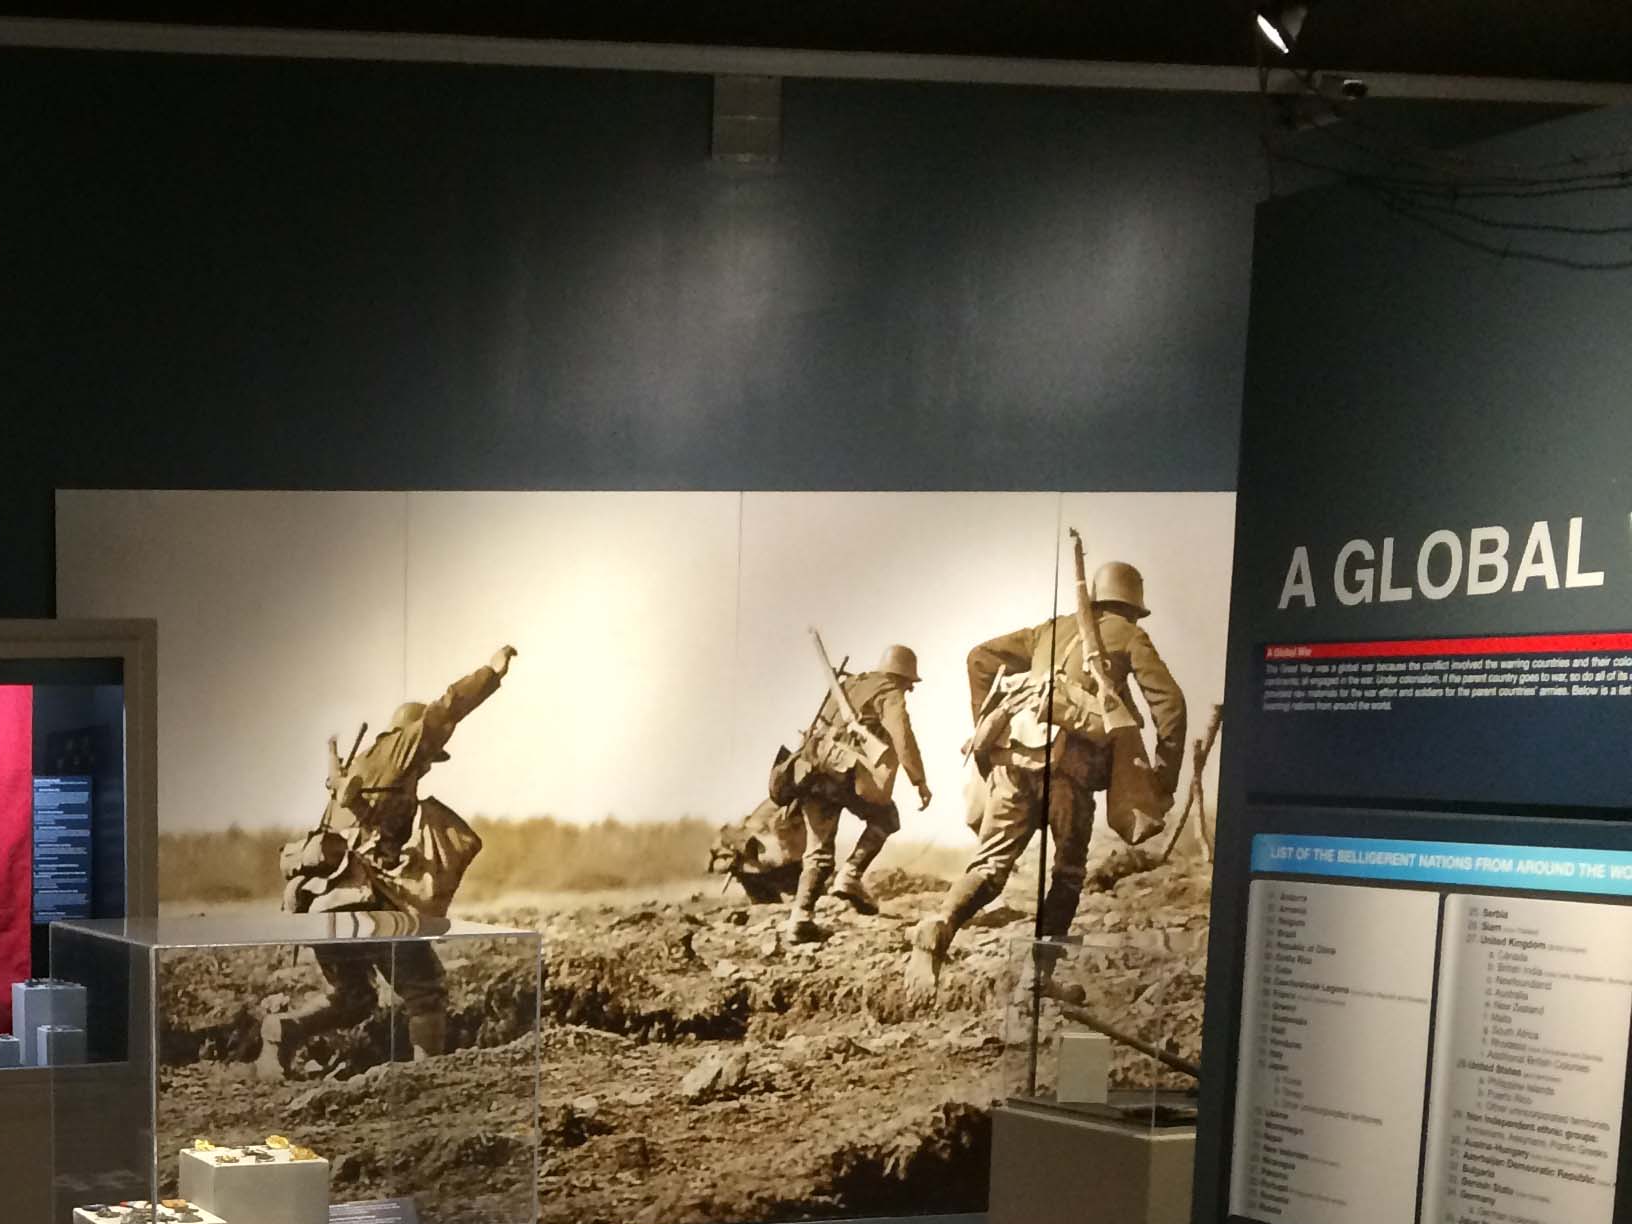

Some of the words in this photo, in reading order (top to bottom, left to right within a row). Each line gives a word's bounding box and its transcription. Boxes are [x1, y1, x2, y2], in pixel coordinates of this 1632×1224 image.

[1277, 546, 1317, 610] A
[1332, 516, 1606, 607] GLOBAL
[1451, 659, 1483, 670] involved
[1485, 659, 1498, 668] the
[1500, 659, 1530, 671] warring
[1532, 658, 1570, 668] countries
[1572, 657, 1589, 668] and
[1591, 656, 1611, 667] their
[1488, 673, 1518, 684] country
[1519, 673, 1540, 685] goes
[1541, 672, 1550, 682] to
[1570, 673, 1581, 682] so
[1582, 672, 1594, 681] do
[1595, 671, 1606, 682] all
[1606, 671, 1616, 681] of
[1571, 685, 1599, 696] Below
[1271, 846, 1294, 859] LIST
[1296, 847, 1312, 861] OF
[1313, 848, 1335, 863] THE
[1337, 849, 1416, 867] BELLIGERENT
[1419, 853, 1473, 870] NATIONS
[1475, 856, 1513, 873] FROM
[1516, 859, 1575, 877] AROUND
[1578, 863, 1607, 879] THE
[1508, 937, 1546, 950] Kingdom
